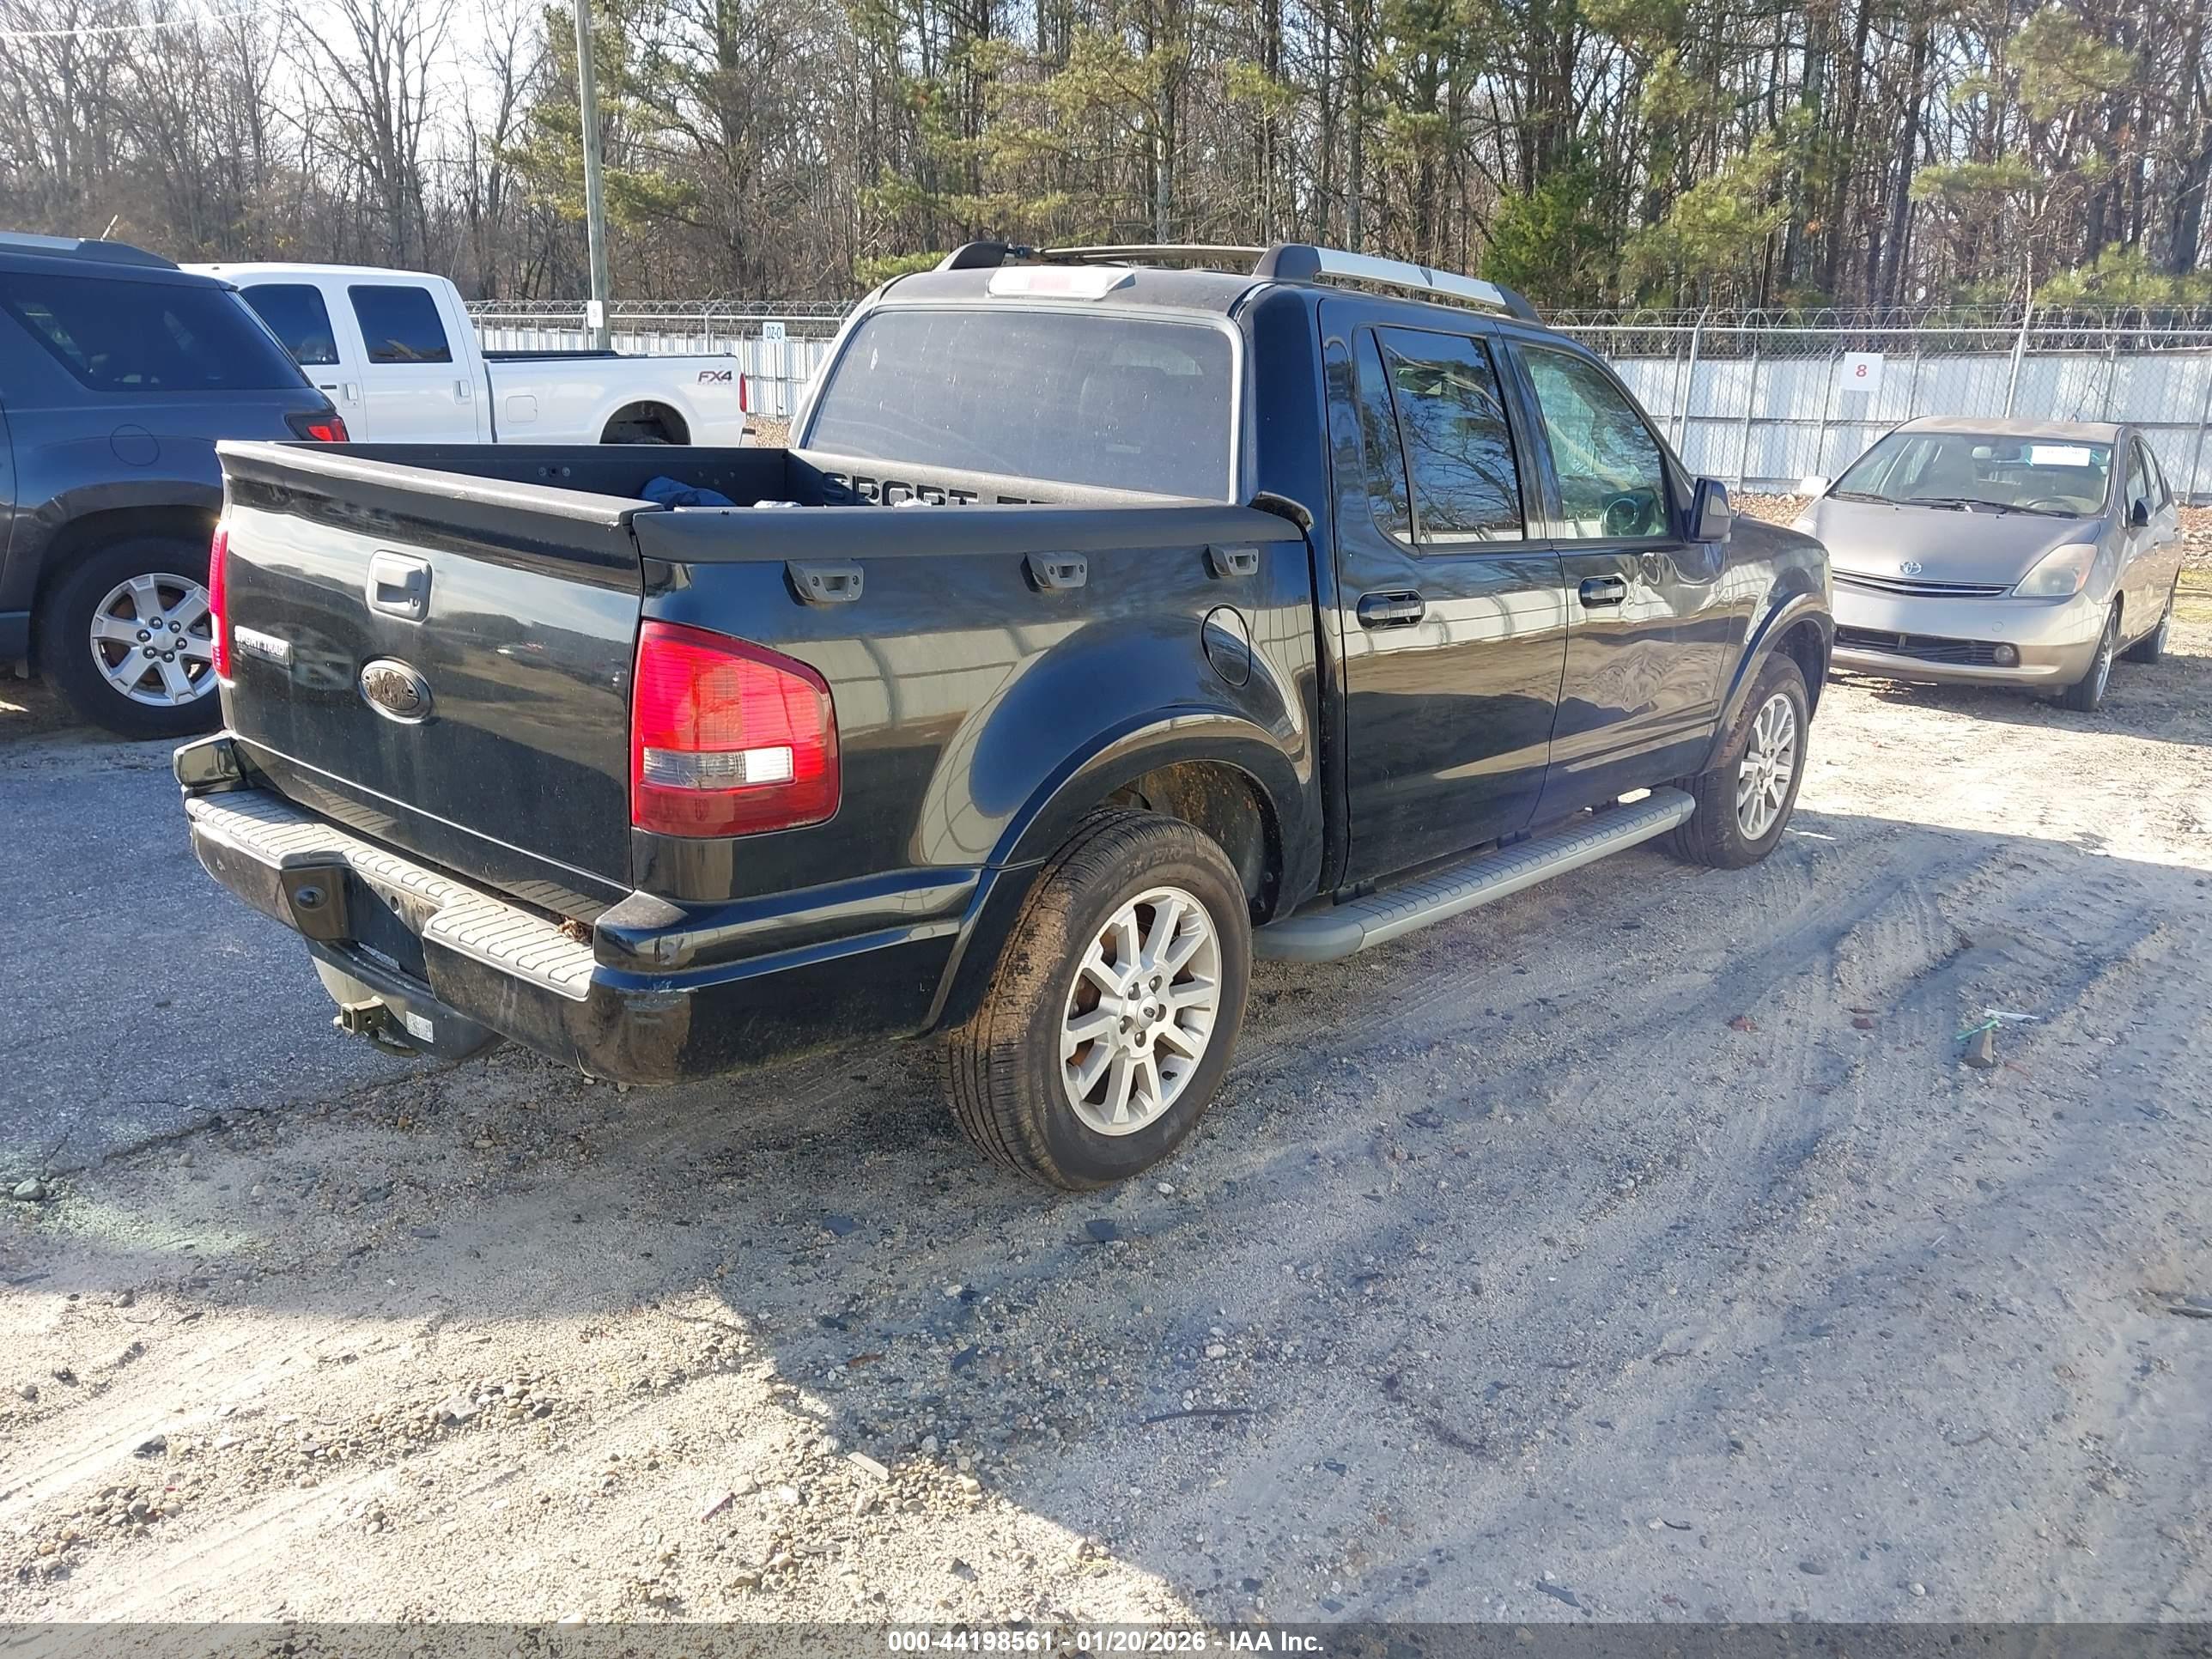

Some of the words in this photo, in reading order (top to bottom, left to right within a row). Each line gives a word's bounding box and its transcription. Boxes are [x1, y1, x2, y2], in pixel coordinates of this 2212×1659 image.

[592, 308, 598, 318] 5
[698, 370, 732, 383] FX4
[1856, 364, 1868, 378] 8
